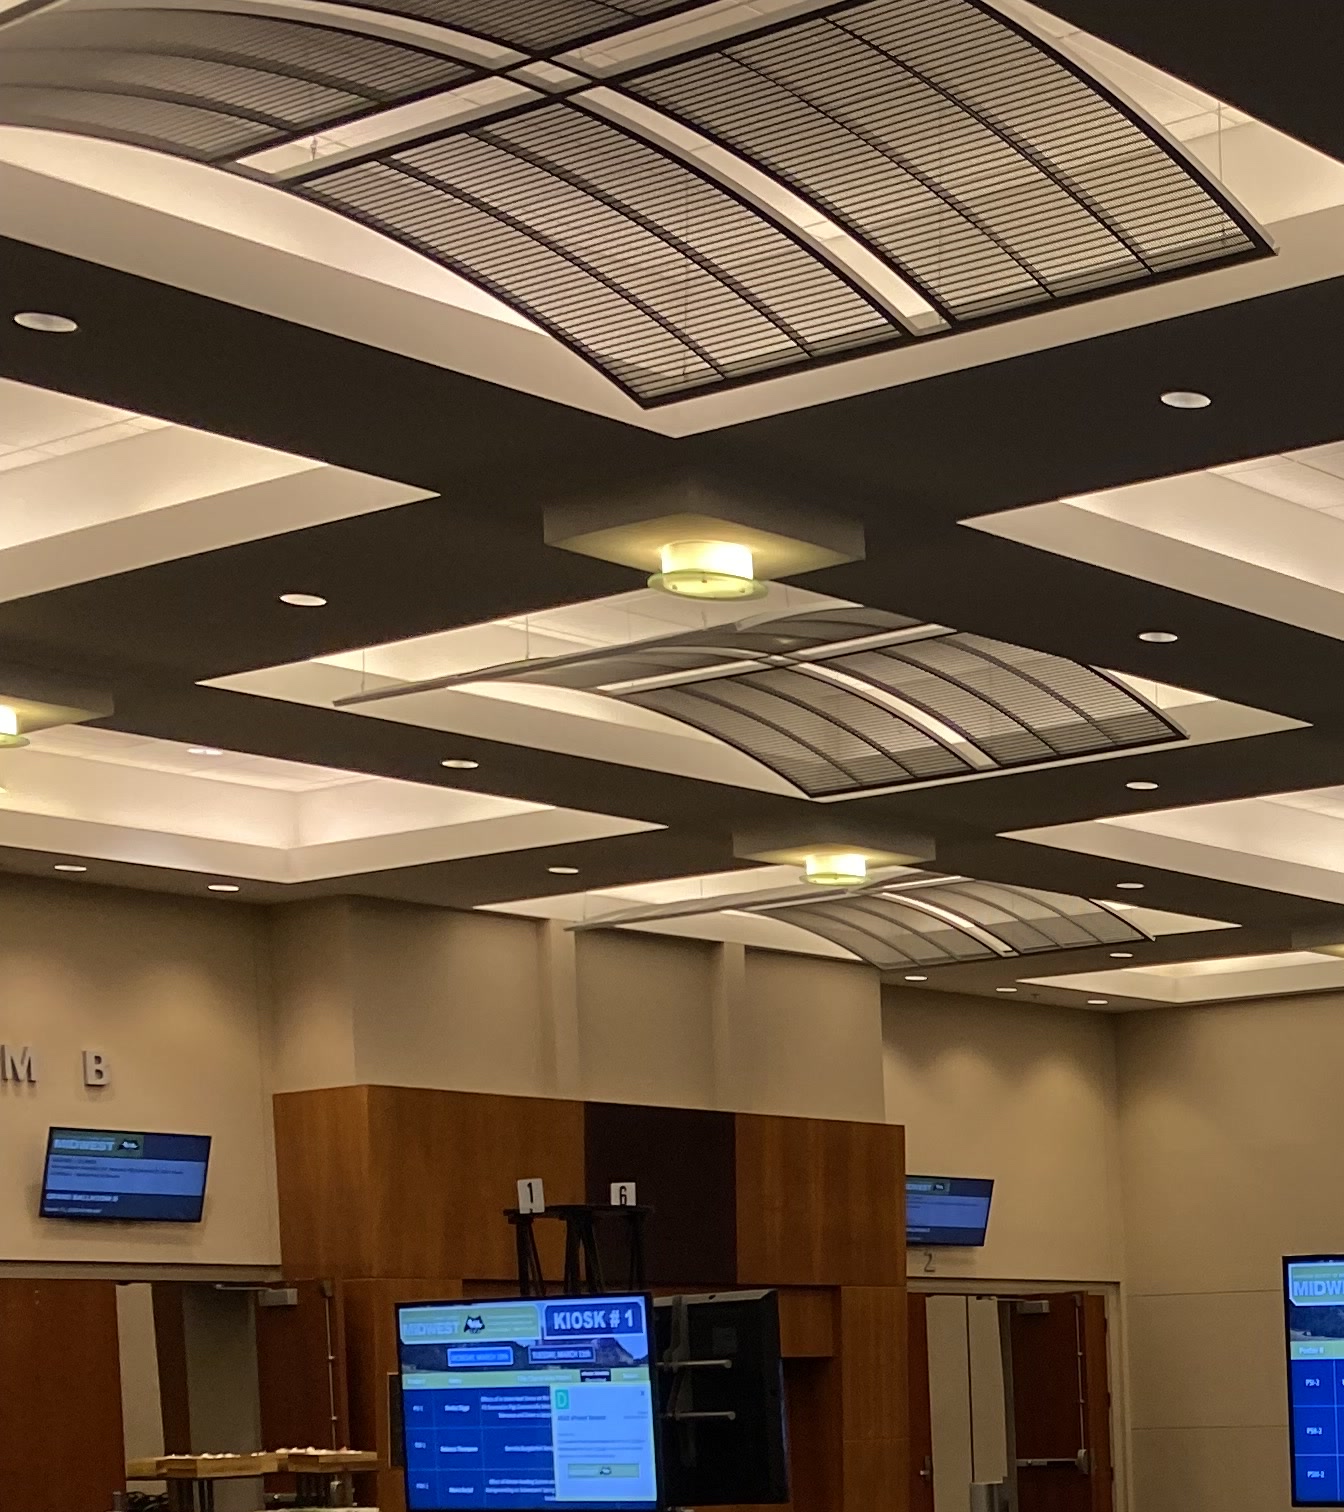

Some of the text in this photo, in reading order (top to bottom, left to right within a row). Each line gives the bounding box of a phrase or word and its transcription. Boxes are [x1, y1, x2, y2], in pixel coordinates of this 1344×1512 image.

[82, 1050, 112, 1086] B
[527, 1182, 534, 1203] 1
[553, 1309, 634, 1329] KIOSK # 1
